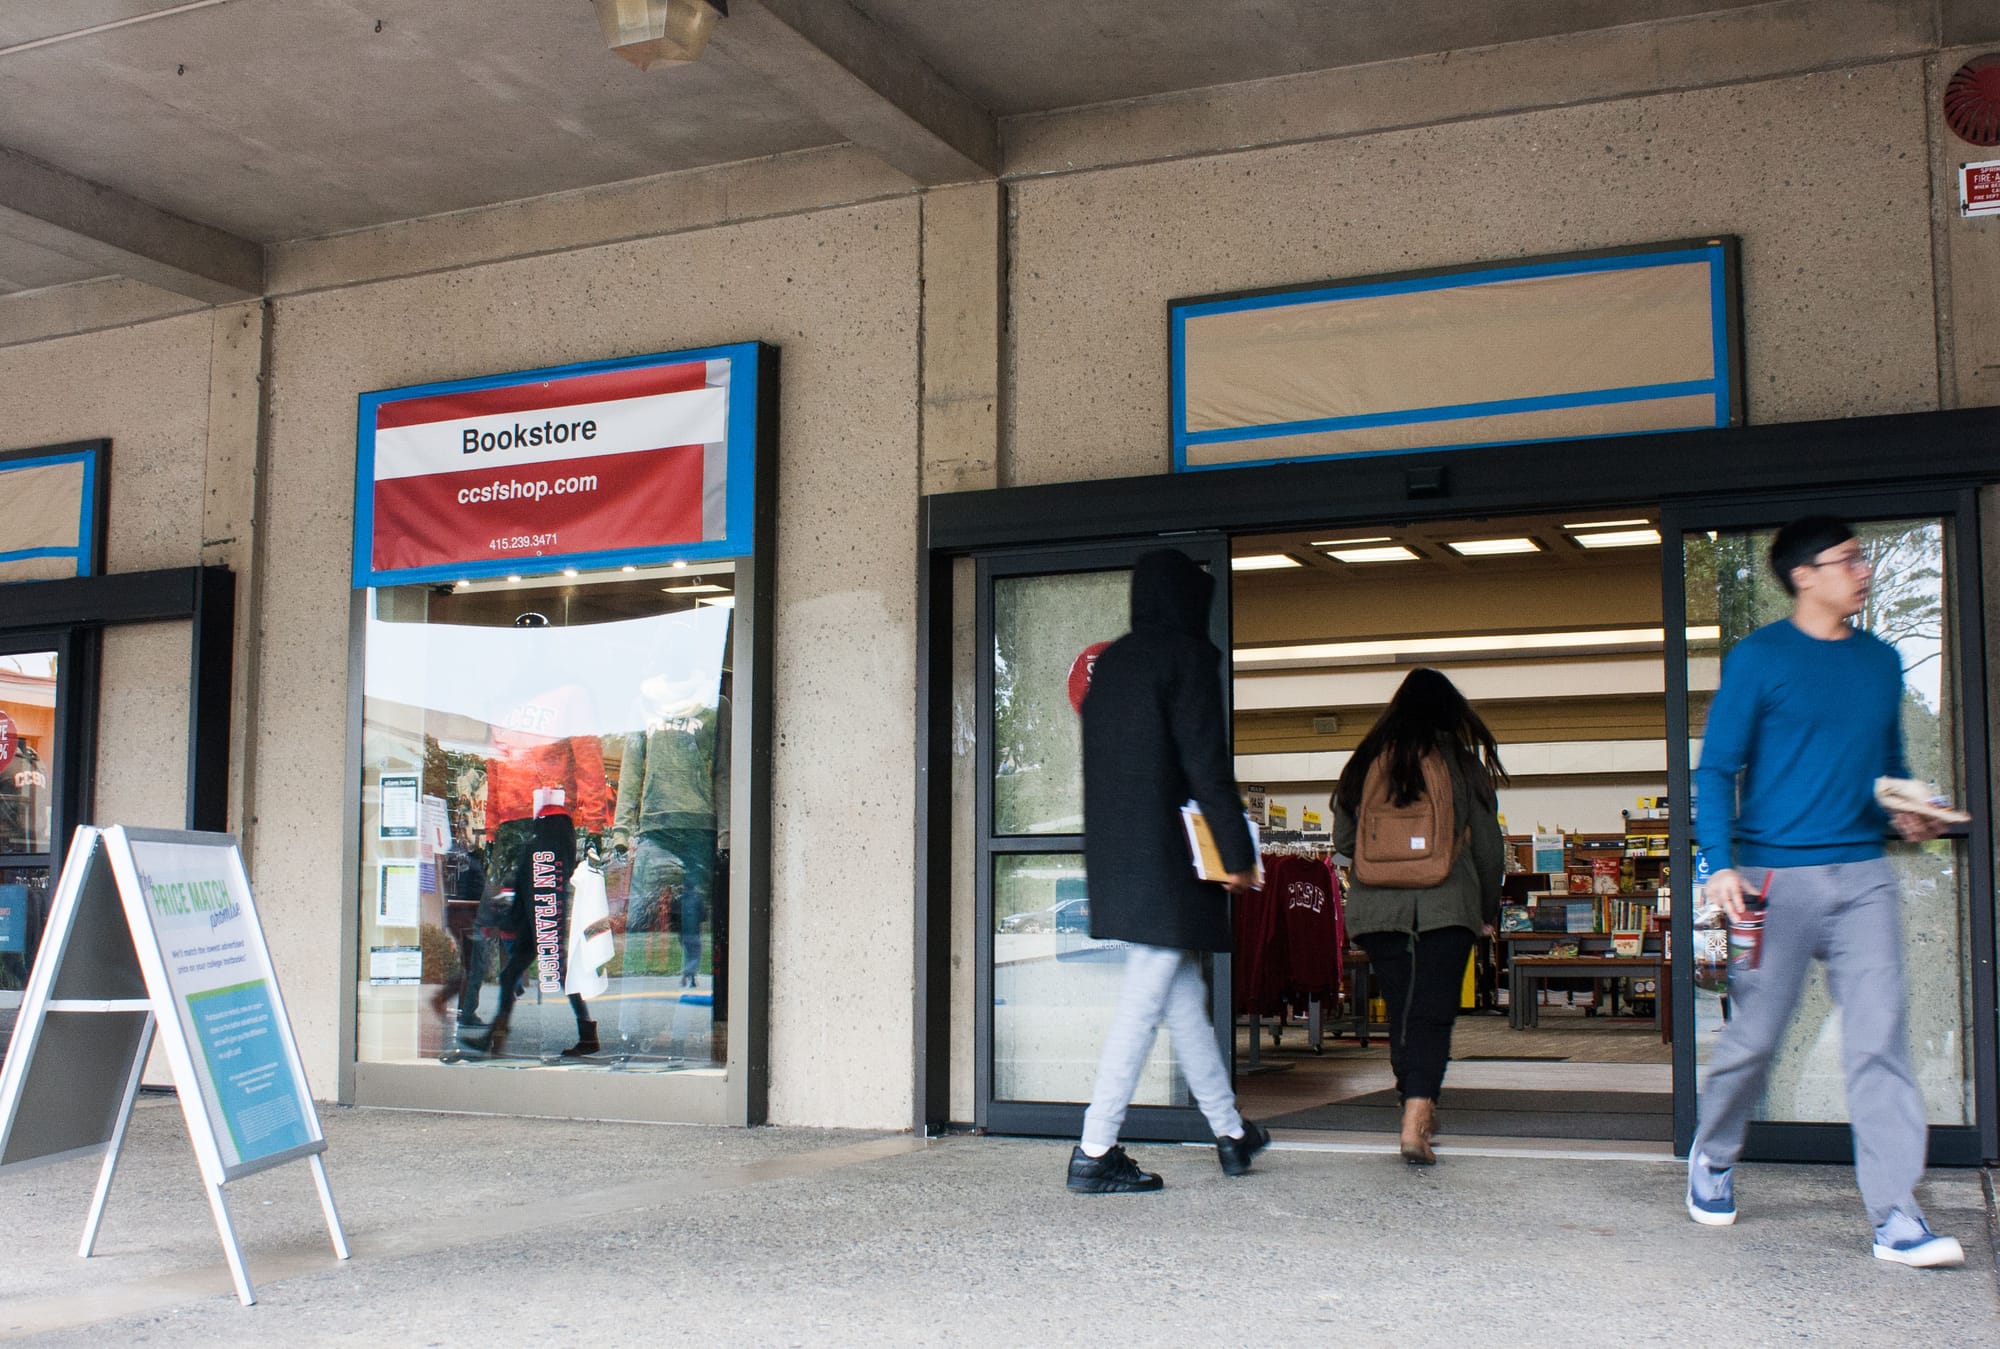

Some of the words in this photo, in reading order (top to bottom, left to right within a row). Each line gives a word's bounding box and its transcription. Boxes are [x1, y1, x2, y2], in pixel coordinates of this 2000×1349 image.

[1974, 173, 1991, 183] FIRE
[463, 420, 597, 454] Bookstore
[457, 475, 598, 504] ccsfshop.com
[489, 533, 558, 550] 415.239.3471
[533, 851, 556, 888] SAN
[151, 883, 191, 916] PRICE
[188, 880, 232, 913] MATCH
[534, 893, 560, 993] FRANCISCO
